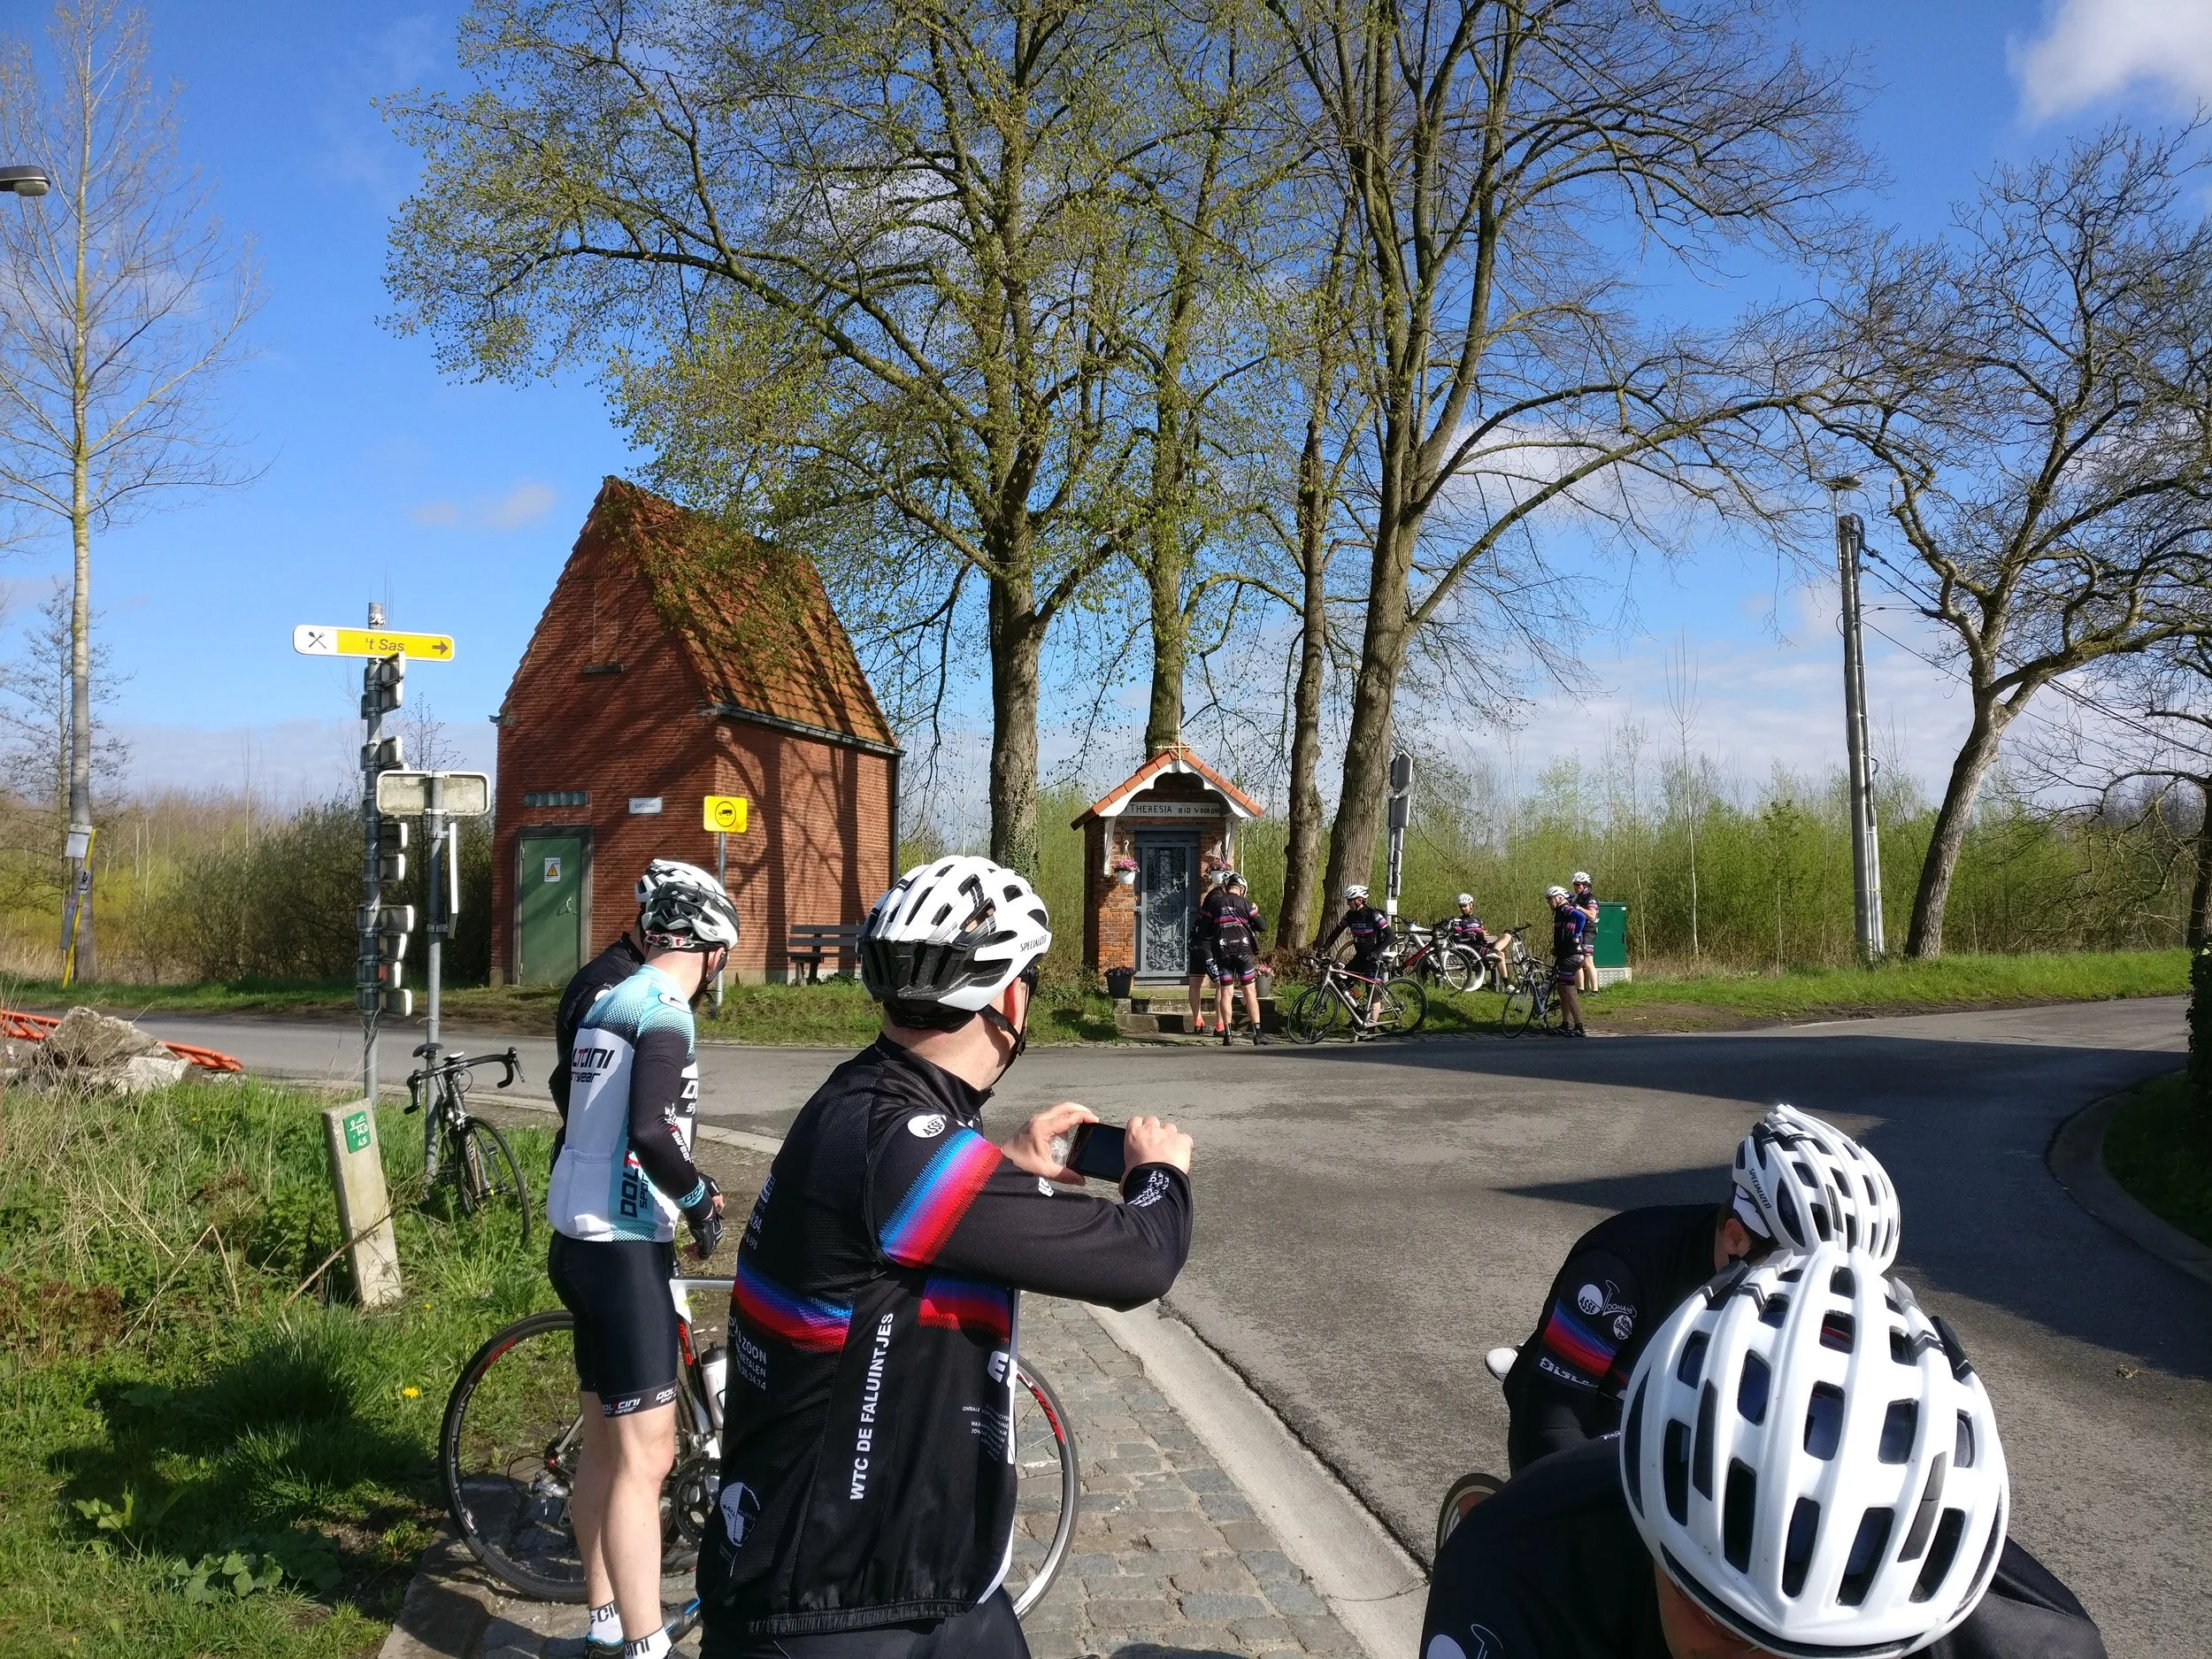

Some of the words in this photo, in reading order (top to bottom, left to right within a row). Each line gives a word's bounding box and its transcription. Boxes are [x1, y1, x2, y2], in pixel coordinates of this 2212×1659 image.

[365, 638, 375, 650] 't
[378, 639, 405, 652] Sas
[1130, 803, 1172, 814] THERESIA
[1748, 1168, 1772, 1210] SPECIALIZED
[1578, 1296, 1597, 1314] ASSE
[741, 1336, 767, 1364] ZOON
[860, 1312, 894, 1424] FALUINTJES
[856, 1428, 873, 1452] DE
[849, 1457, 869, 1500] WTC
